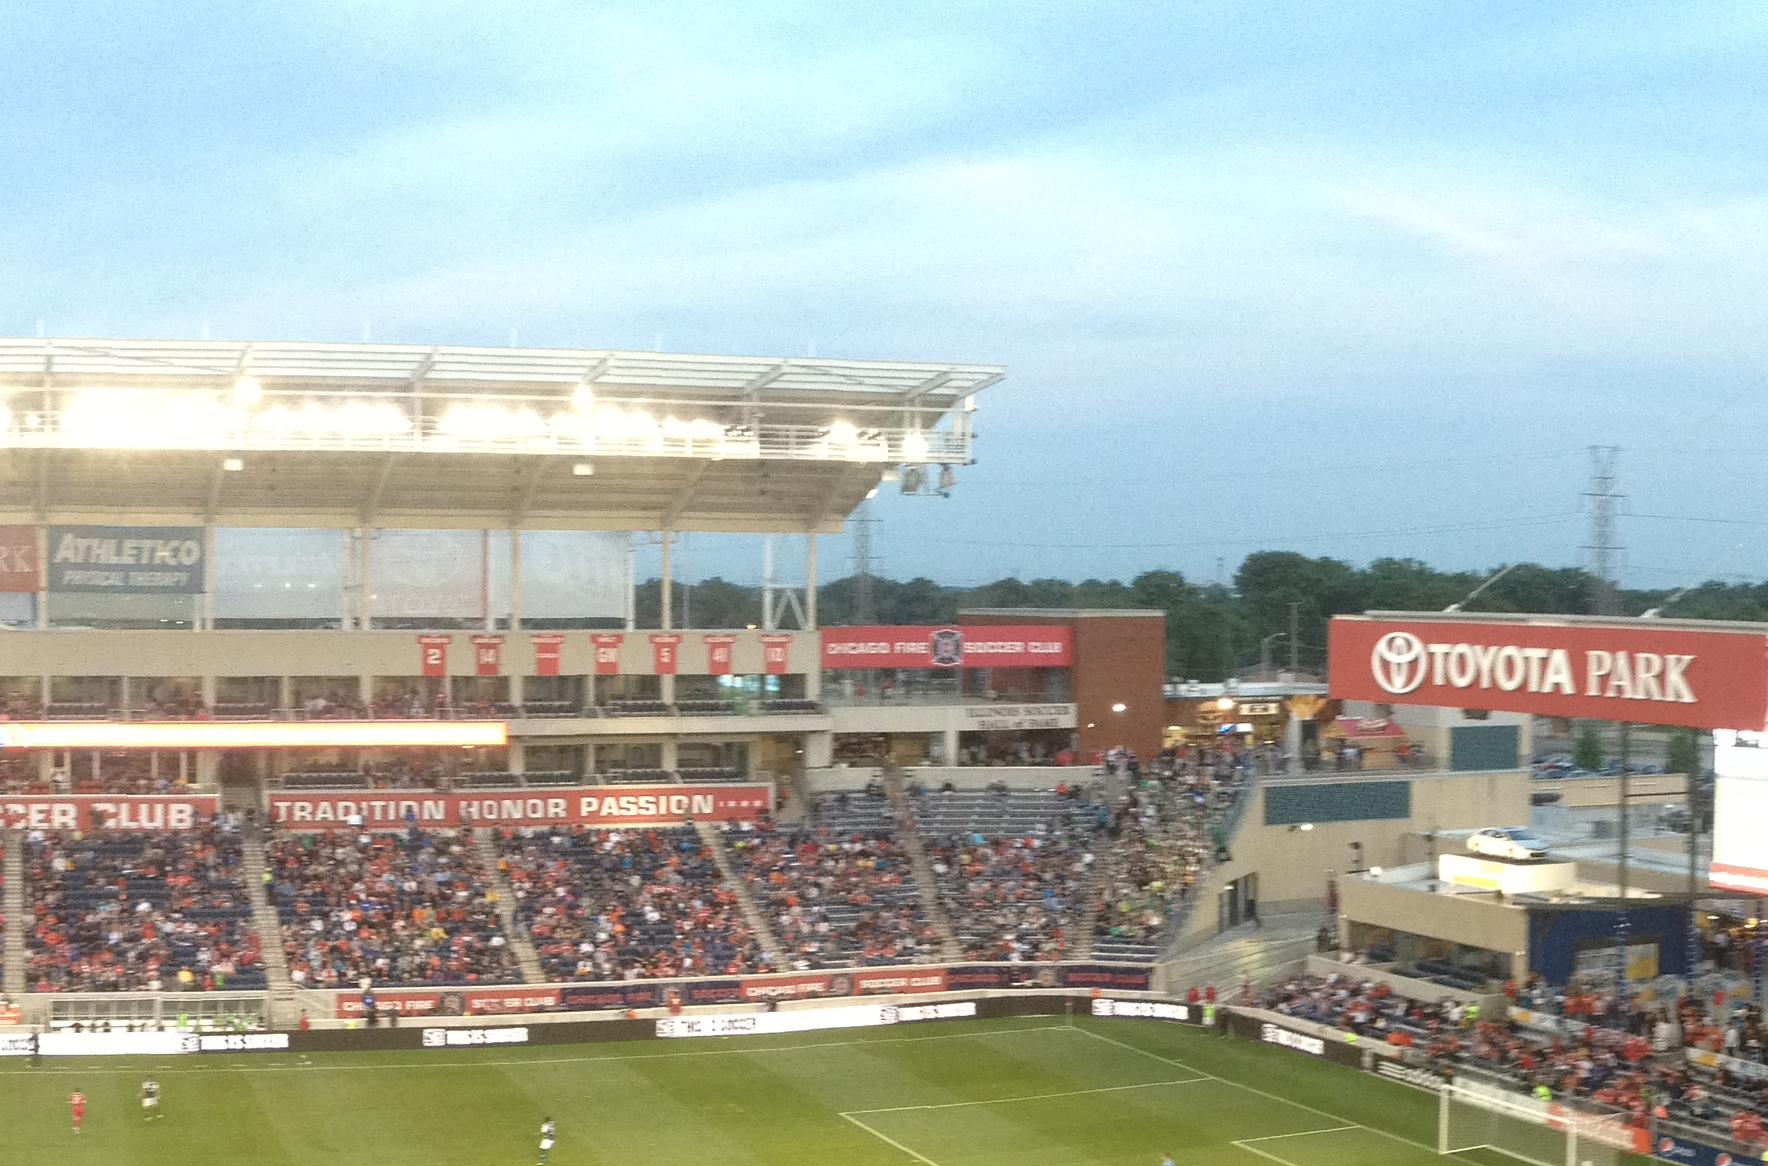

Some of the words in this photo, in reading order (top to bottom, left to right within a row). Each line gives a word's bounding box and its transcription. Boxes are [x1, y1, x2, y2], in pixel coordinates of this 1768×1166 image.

[54, 533, 200, 566] ATHLETICO
[427, 648, 442, 664] 2
[827, 641, 891, 654] CHICAGO
[894, 641, 930, 653] FIRE
[964, 641, 1025, 653] SOCCER
[1027, 641, 1063, 653] CLUB
[1427, 643, 1577, 694] TOYOTA
[1584, 651, 1698, 703] PARK
[459, 798, 568, 821] HONOR
[579, 794, 714, 817] PASSION
[405, 1000, 436, 1010] FIRE
